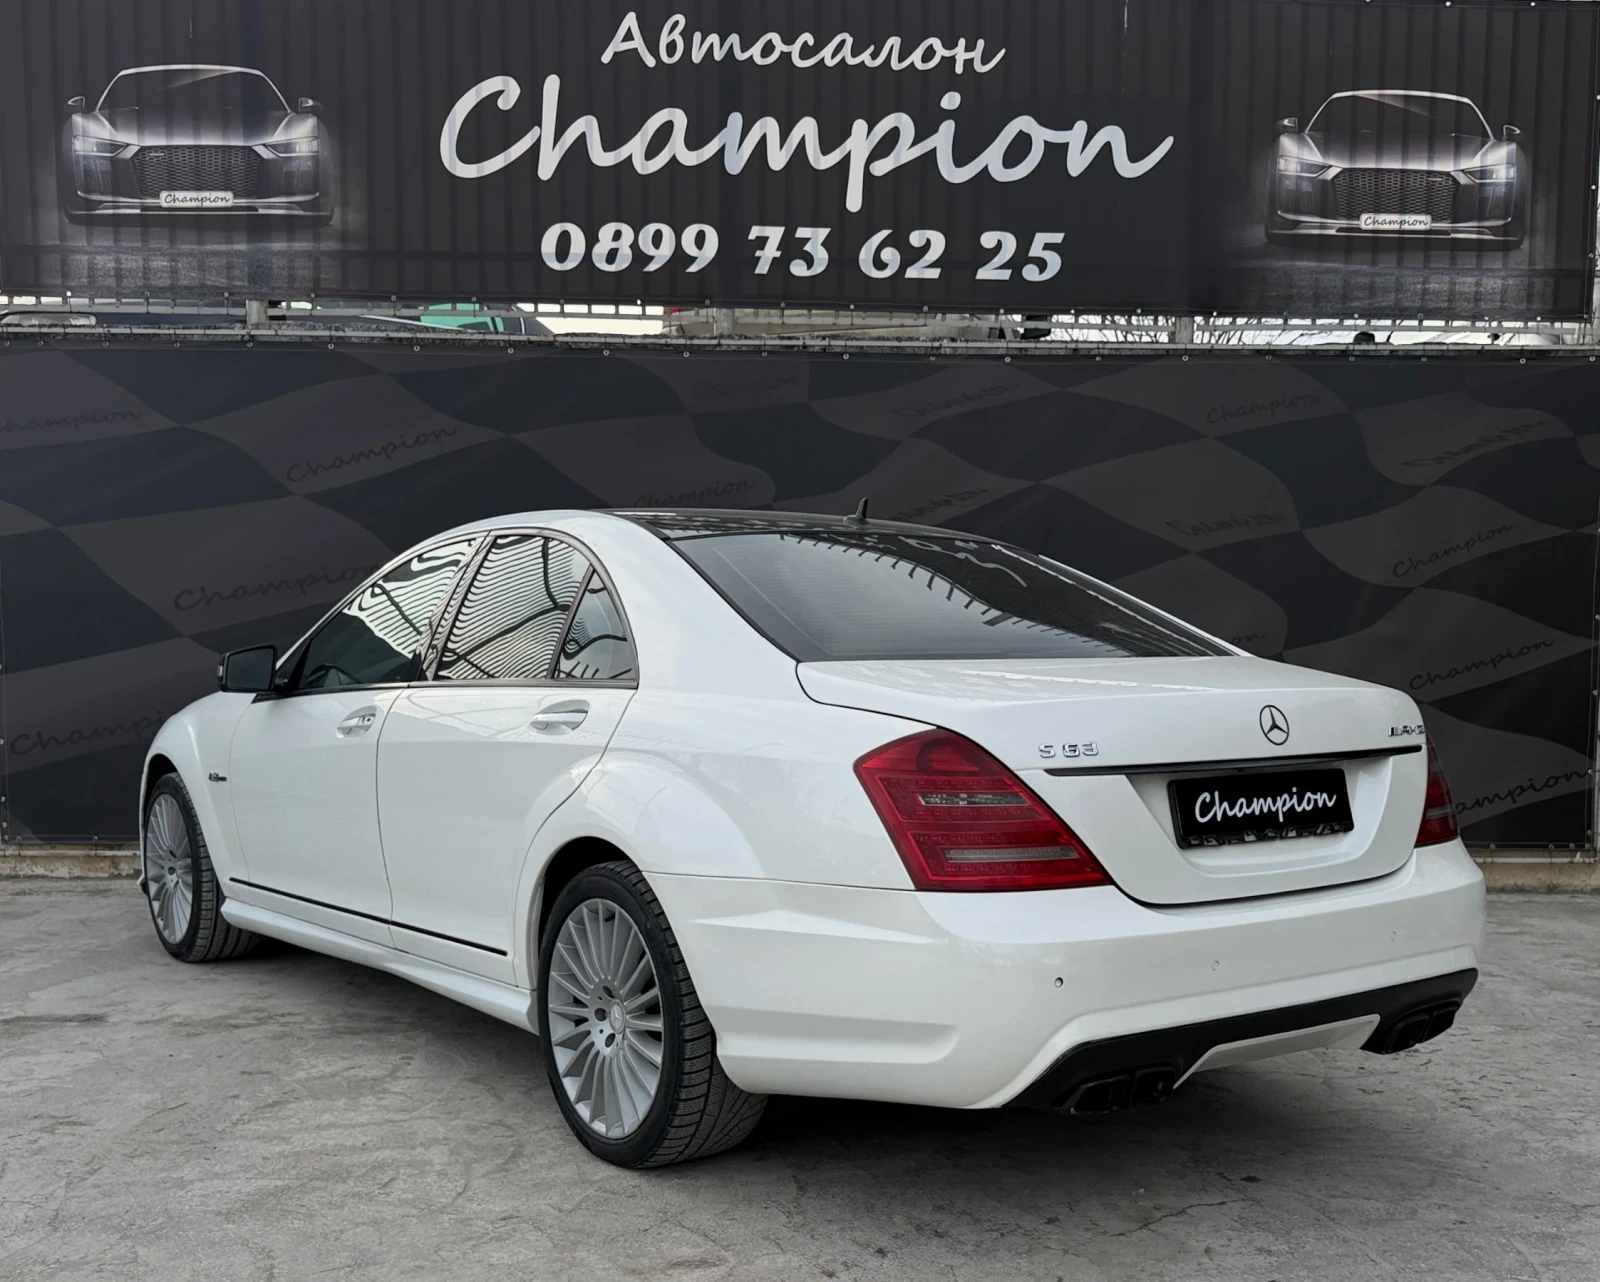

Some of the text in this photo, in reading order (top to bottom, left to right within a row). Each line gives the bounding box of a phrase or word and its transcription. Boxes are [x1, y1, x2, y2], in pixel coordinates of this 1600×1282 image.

[600, 11, 1006, 76] Автосалон
[439, 74, 1174, 213] Champion
[164, 193, 231, 207] Champion
[1363, 216, 1429, 230] Champion
[540, 221, 1065, 282] 0899 73 62 25
[0, 410, 143, 434] hampion
[286, 425, 458, 483] Champion
[1392, 523, 1512, 579] Champion
[1408, 637, 1556, 690] Champion
[9, 709, 166, 757] Champi
[1038, 741, 1099, 759] S 63
[1194, 786, 1337, 824] Champion
[1454, 769, 1589, 815] ampion
